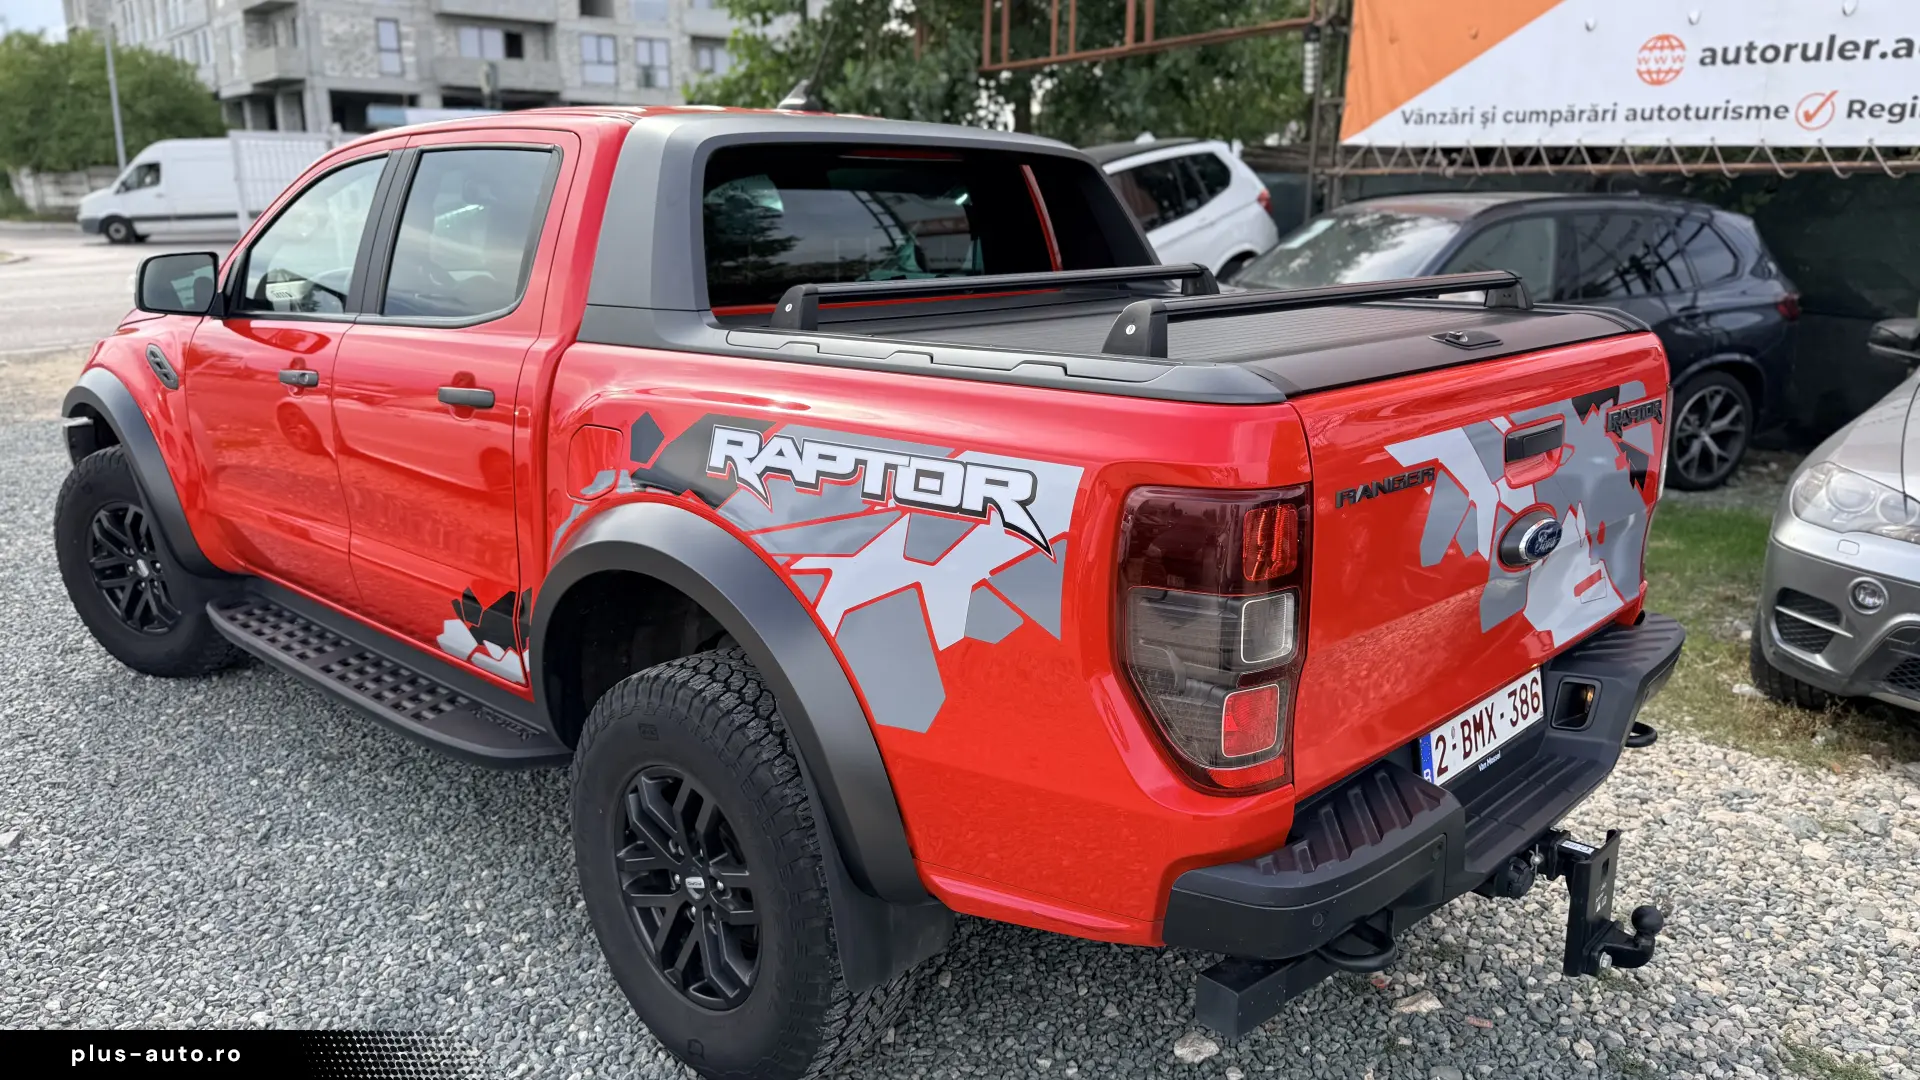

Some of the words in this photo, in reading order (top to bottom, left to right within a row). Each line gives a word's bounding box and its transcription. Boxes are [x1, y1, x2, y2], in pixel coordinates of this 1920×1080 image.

[1699, 34, 1920, 66] autoruler.a
[1401, 105, 1474, 125] Vânzări
[1502, 102, 1618, 127] cumpărări
[1625, 98, 1790, 122] autoturisme
[1847, 94, 1920, 124] Regi
[1606, 397, 1663, 438] RAPTOR
[705, 423, 1057, 566] RAPTOR
[1335, 466, 1435, 508] RANGER
